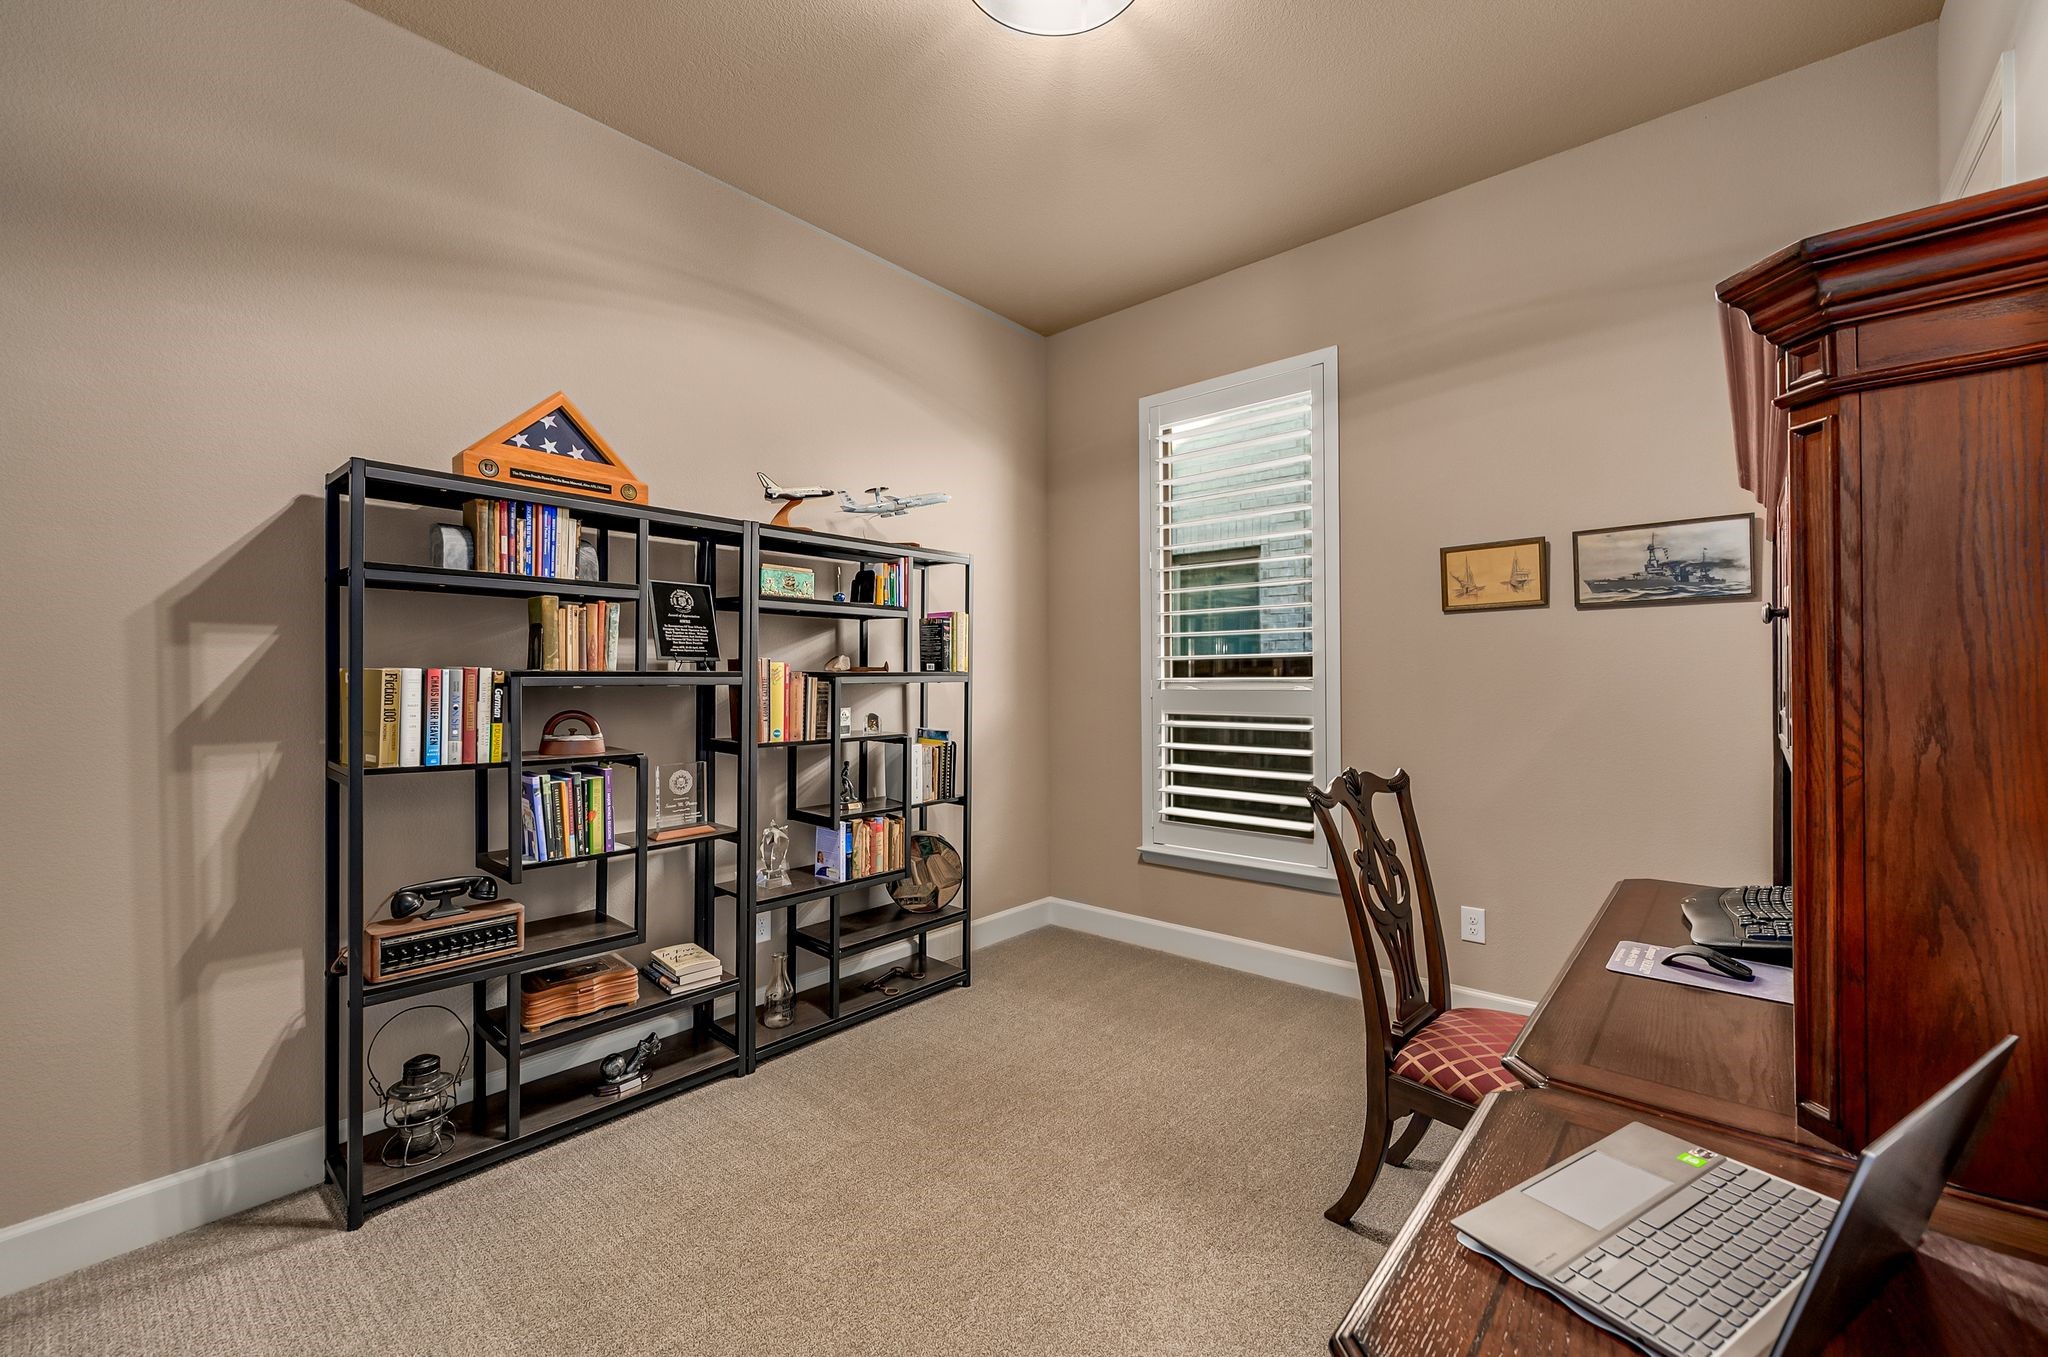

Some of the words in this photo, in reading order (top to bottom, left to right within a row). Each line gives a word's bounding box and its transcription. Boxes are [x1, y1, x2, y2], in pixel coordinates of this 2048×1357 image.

[384, 672, 398, 706] Fiction
[430, 675, 440, 696] CHAOS
[430, 698, 440, 720] UNDER
[494, 688, 504, 718] German
[383, 708, 397, 722] 100
[430, 721, 439, 746] HEAVEN
